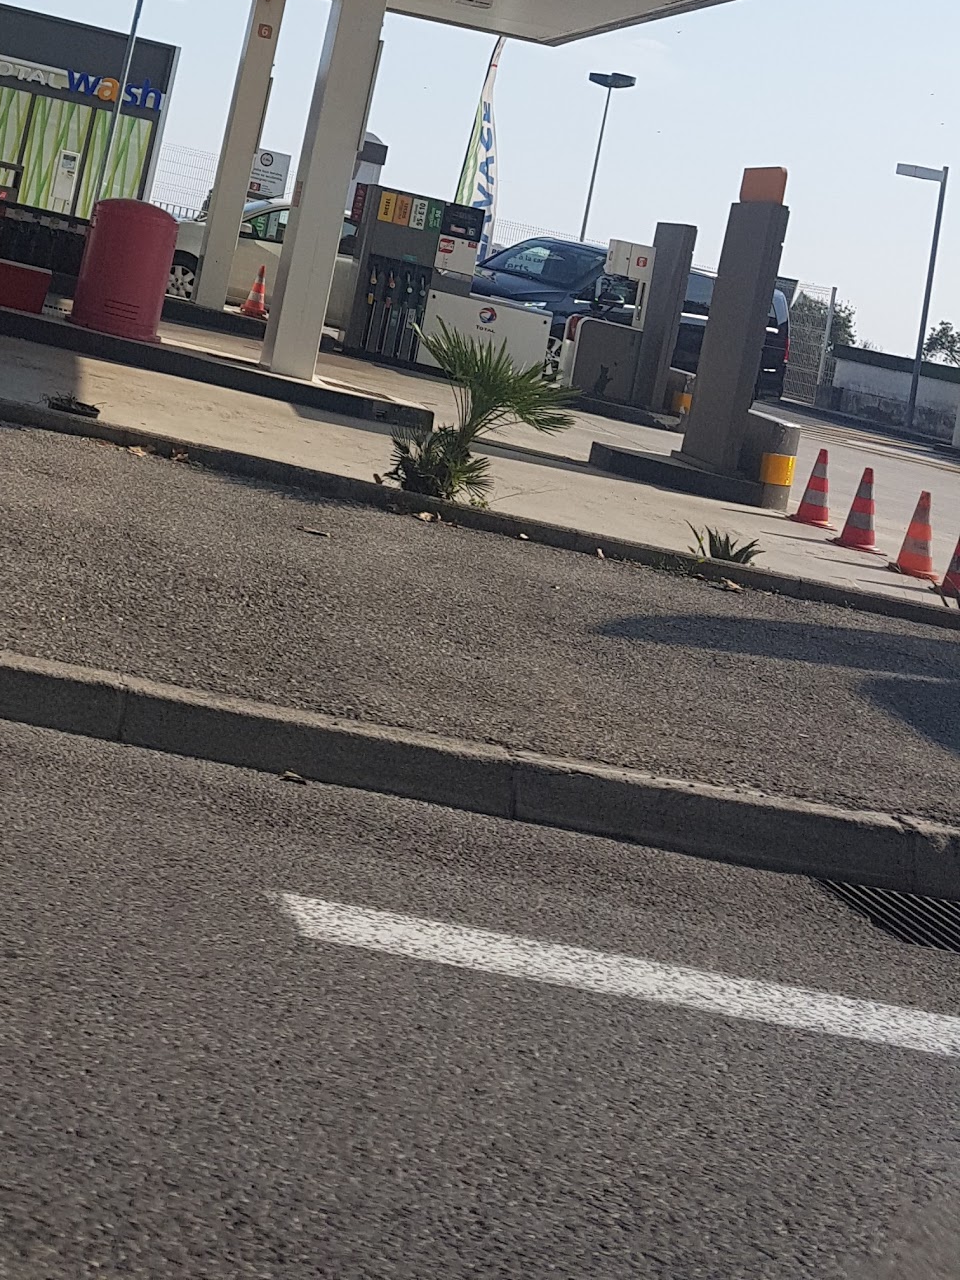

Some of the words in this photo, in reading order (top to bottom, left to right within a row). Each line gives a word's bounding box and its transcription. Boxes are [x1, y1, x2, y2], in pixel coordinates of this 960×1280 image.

[261, 26, 269, 37] 6
[67, 68, 162, 112] wash
[476, 324, 496, 334] TOTAL
